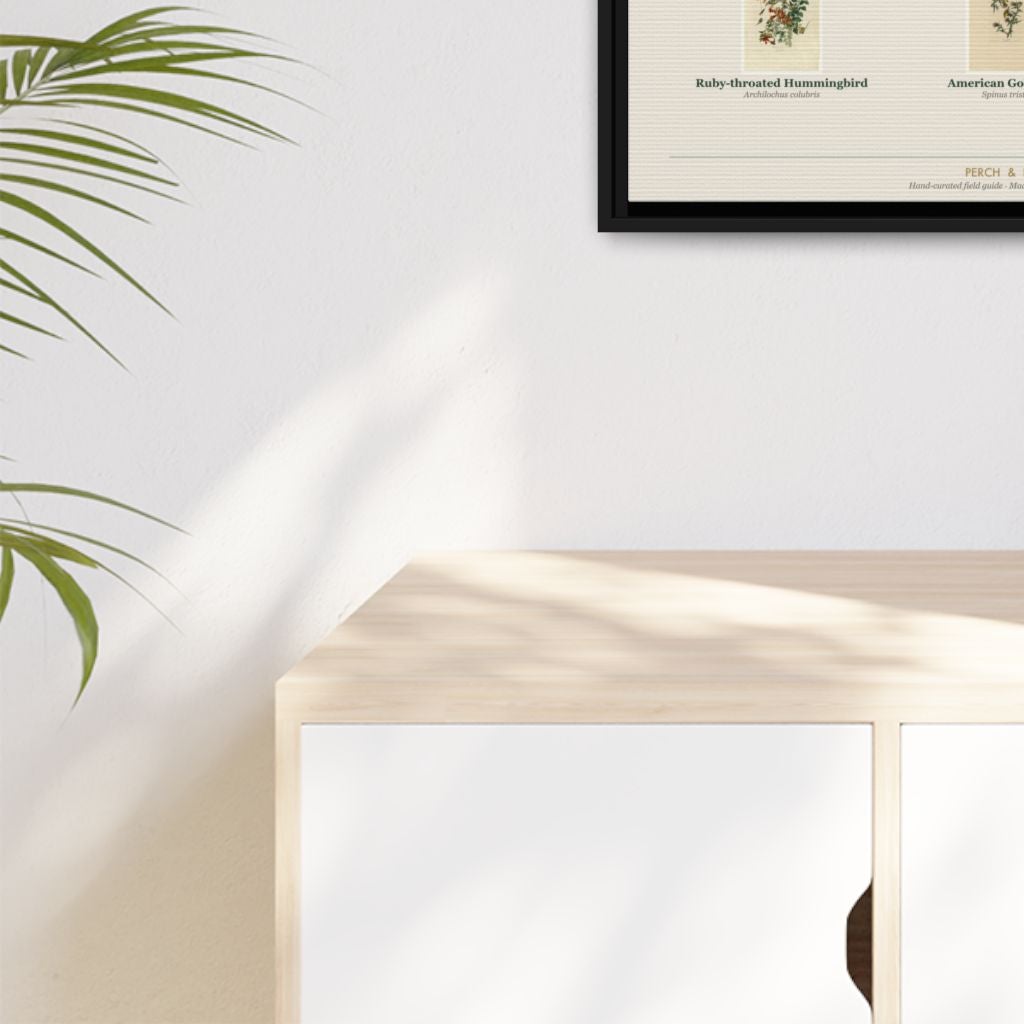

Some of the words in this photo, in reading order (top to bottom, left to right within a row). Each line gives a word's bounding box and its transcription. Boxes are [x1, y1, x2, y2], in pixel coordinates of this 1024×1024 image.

[696, 78, 781, 90] Ruby-throated
[784, 78, 868, 90] Hummingbird
[947, 78, 1004, 88] American
[965, 168, 1000, 178] PERCH
[1008, 168, 1016, 178] &
[908, 181, 962, 190] Hand-curated
[962, 181, 980, 192] field
[981, 181, 1003, 191] guide
